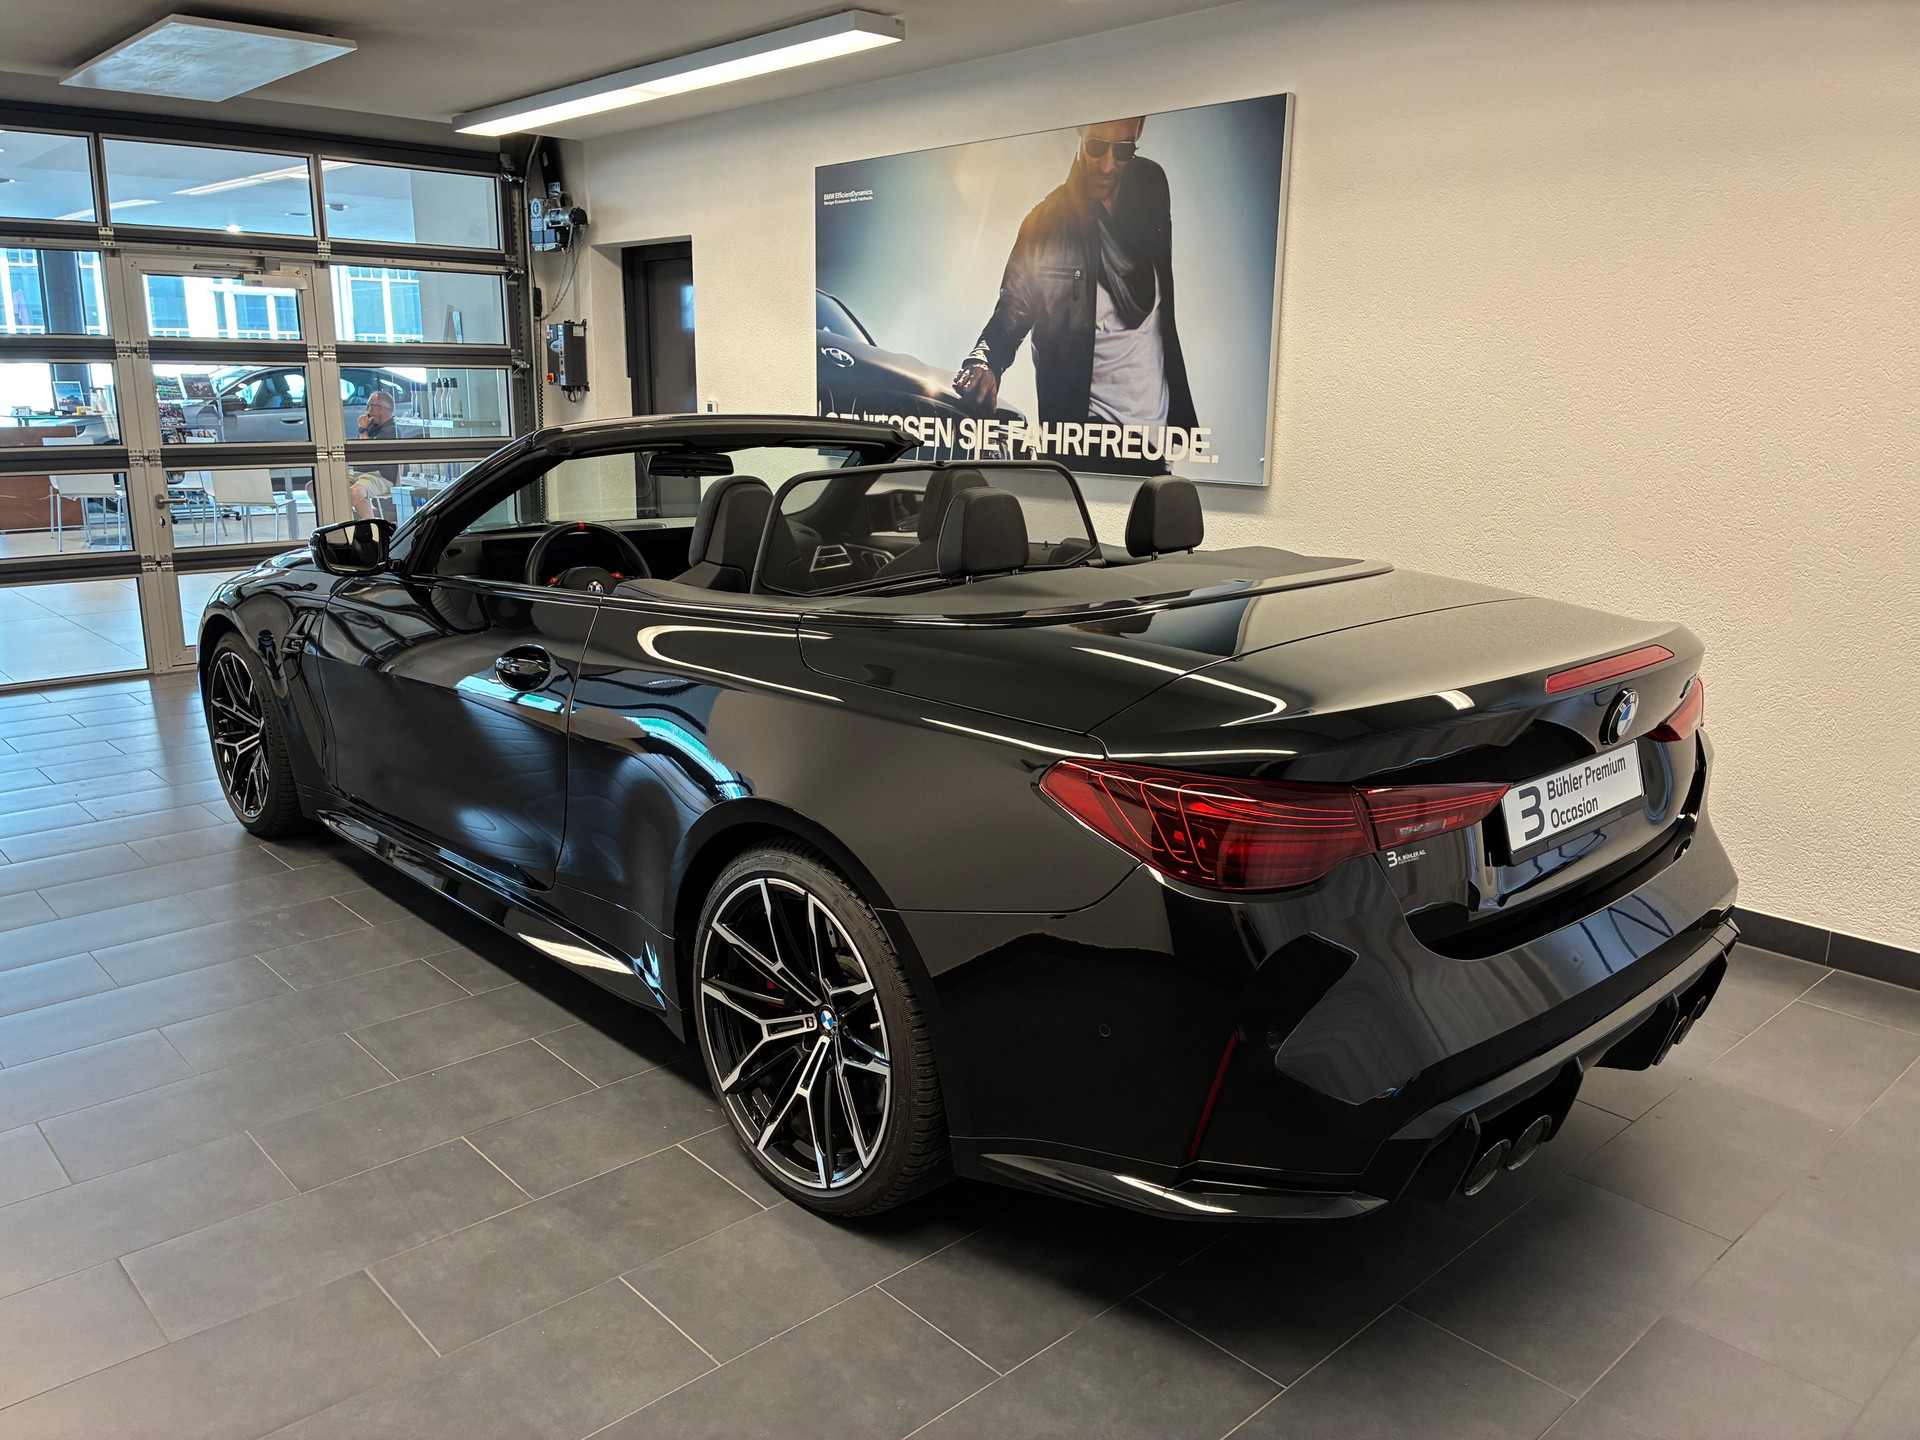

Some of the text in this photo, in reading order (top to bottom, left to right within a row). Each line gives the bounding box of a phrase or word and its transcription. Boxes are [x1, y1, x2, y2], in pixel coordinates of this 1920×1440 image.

[959, 418, 1000, 450] SIE
[1008, 420, 1219, 463] FAHRFREUDE.
[1546, 757, 1626, 801] Bühler Premium
[1550, 796, 1599, 829] Occasion
